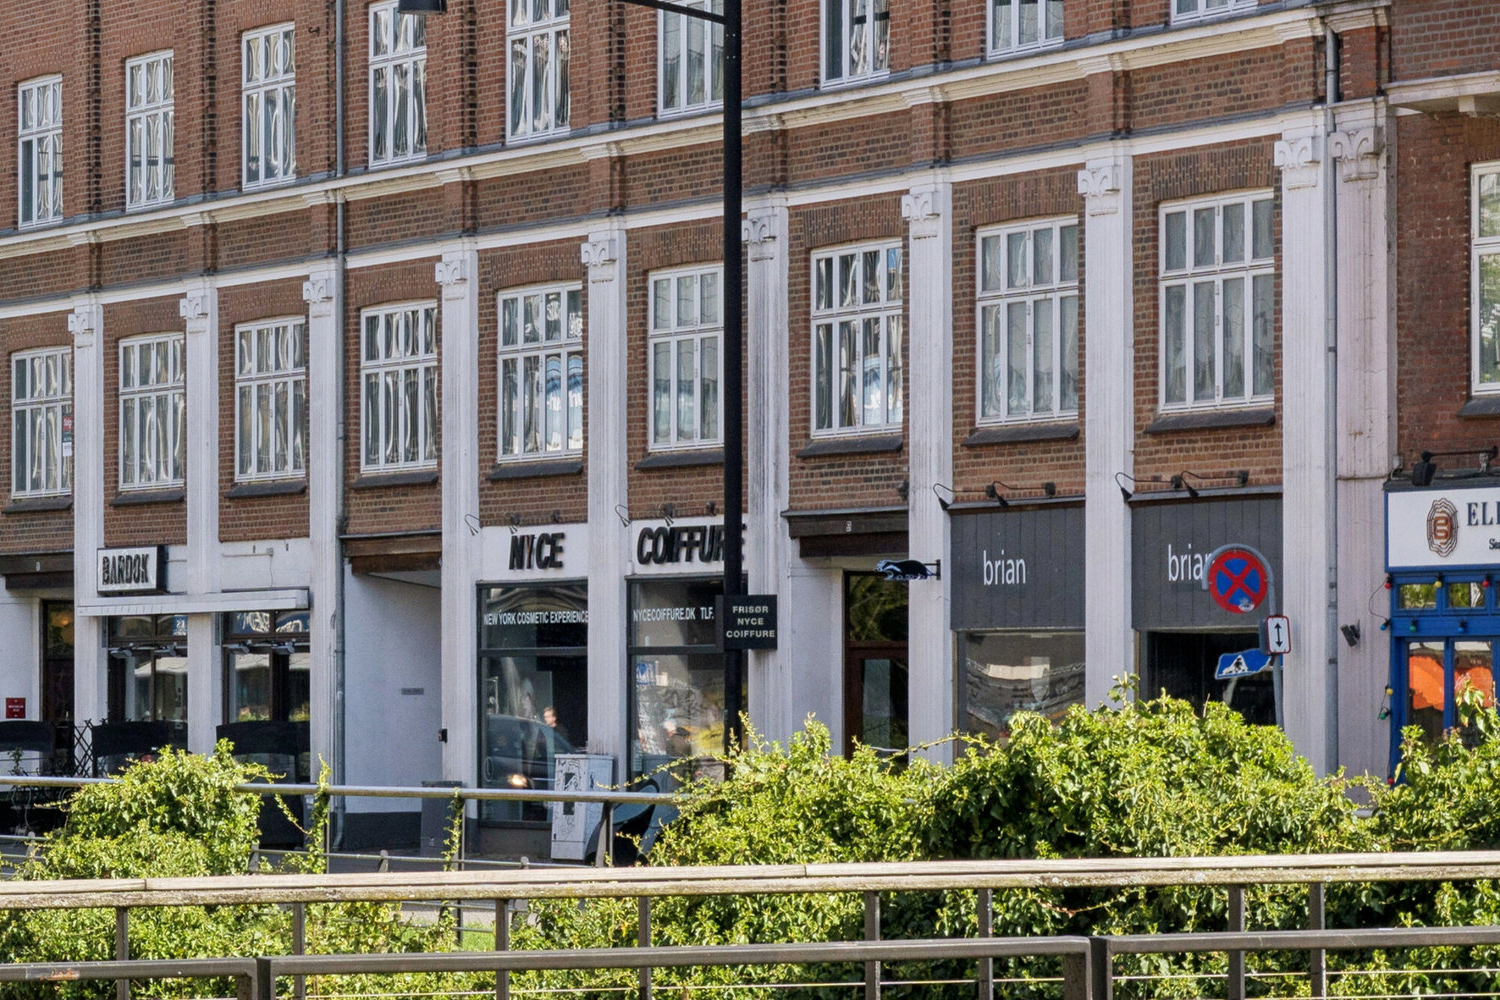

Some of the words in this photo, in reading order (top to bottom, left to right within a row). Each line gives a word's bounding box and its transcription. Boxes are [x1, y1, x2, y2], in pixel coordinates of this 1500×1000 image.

[509, 532, 566, 570] NYCE
[102, 553, 150, 586] BARDOK
[983, 549, 1026, 585] brian
[633, 607, 696, 622] NYCECOIFFURE.DK
[700, 607, 715, 620] TLF.
[732, 605, 769, 614] FRISØR
[484, 612, 498, 626] NEW
[499, 612, 516, 625] YORK
[516, 611, 549, 624] COSMETIC
[550, 610, 588, 624] EXPERIENCE
[737, 617, 764, 626] NYCE
[726, 629, 776, 638] COIFFURE
